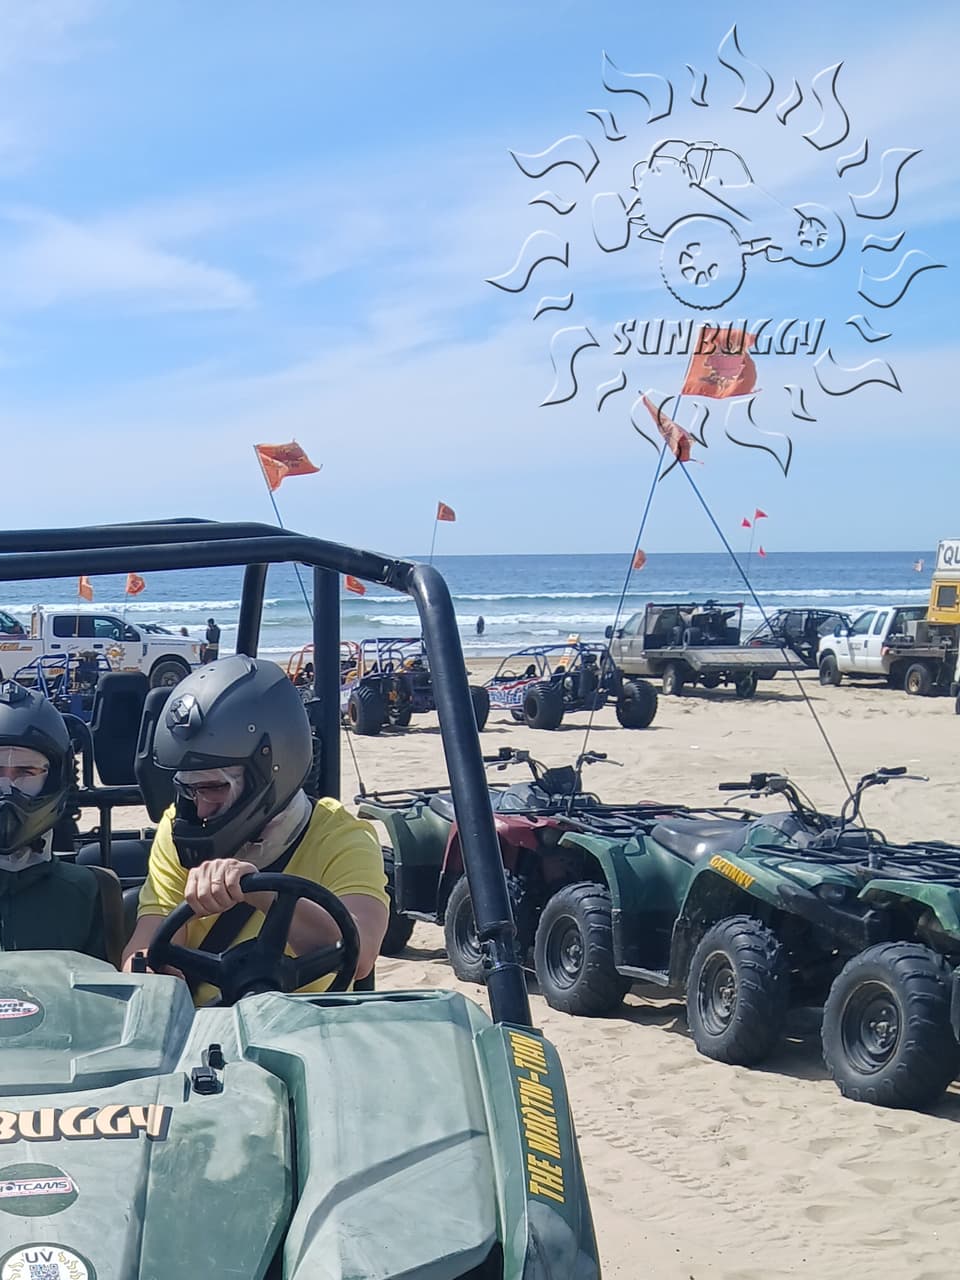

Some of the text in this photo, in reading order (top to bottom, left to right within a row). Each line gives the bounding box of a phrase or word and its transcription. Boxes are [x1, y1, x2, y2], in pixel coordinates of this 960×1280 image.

[509, 1031, 566, 1204] THE MARTIN-TIAN
[24, 1251, 54, 1264] UV
